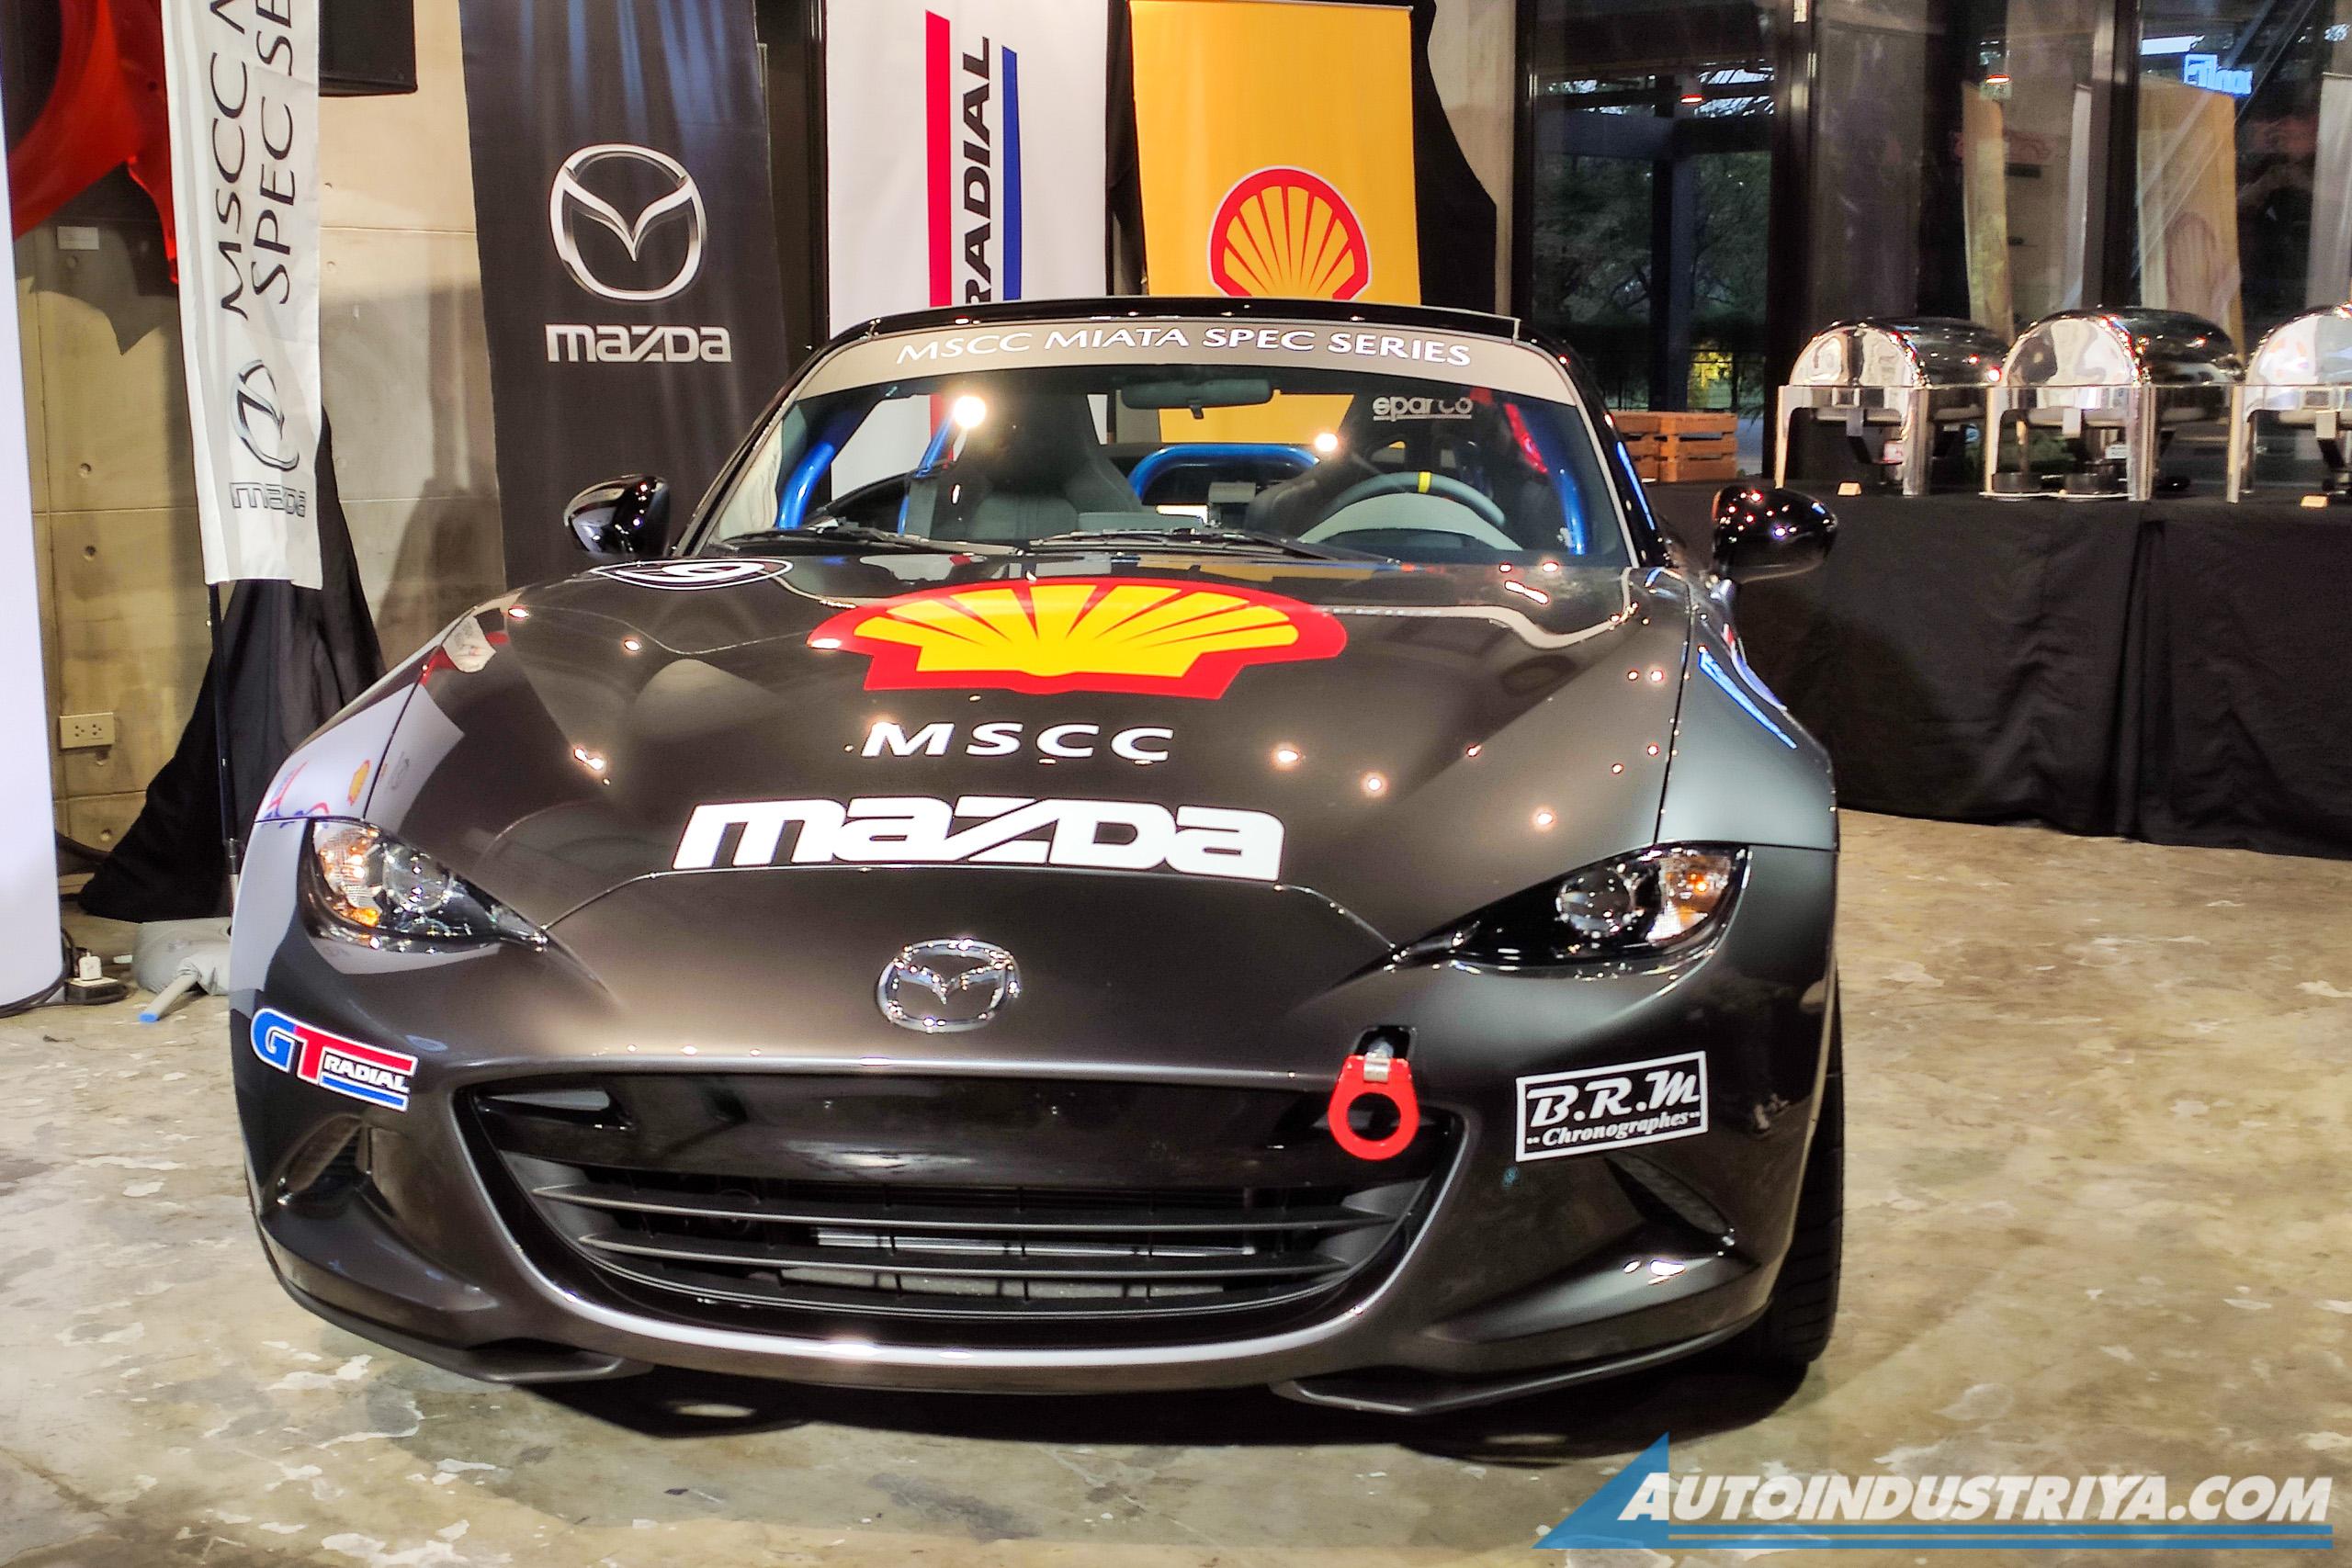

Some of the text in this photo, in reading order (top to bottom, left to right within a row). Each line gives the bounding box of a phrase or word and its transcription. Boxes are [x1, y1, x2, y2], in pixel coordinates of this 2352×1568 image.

[210, 51, 249, 321] MSCC
[251, 96, 296, 305] SPEC
[896, 327, 1471, 367] MSCC MIATA SPEC SERIES
[860, 722, 1174, 762] MSCC
[323, 1054, 411, 1094] RADIAL
[1526, 1069, 1701, 1128] B.R.M
[1542, 1111, 1690, 1147] Chronographes
